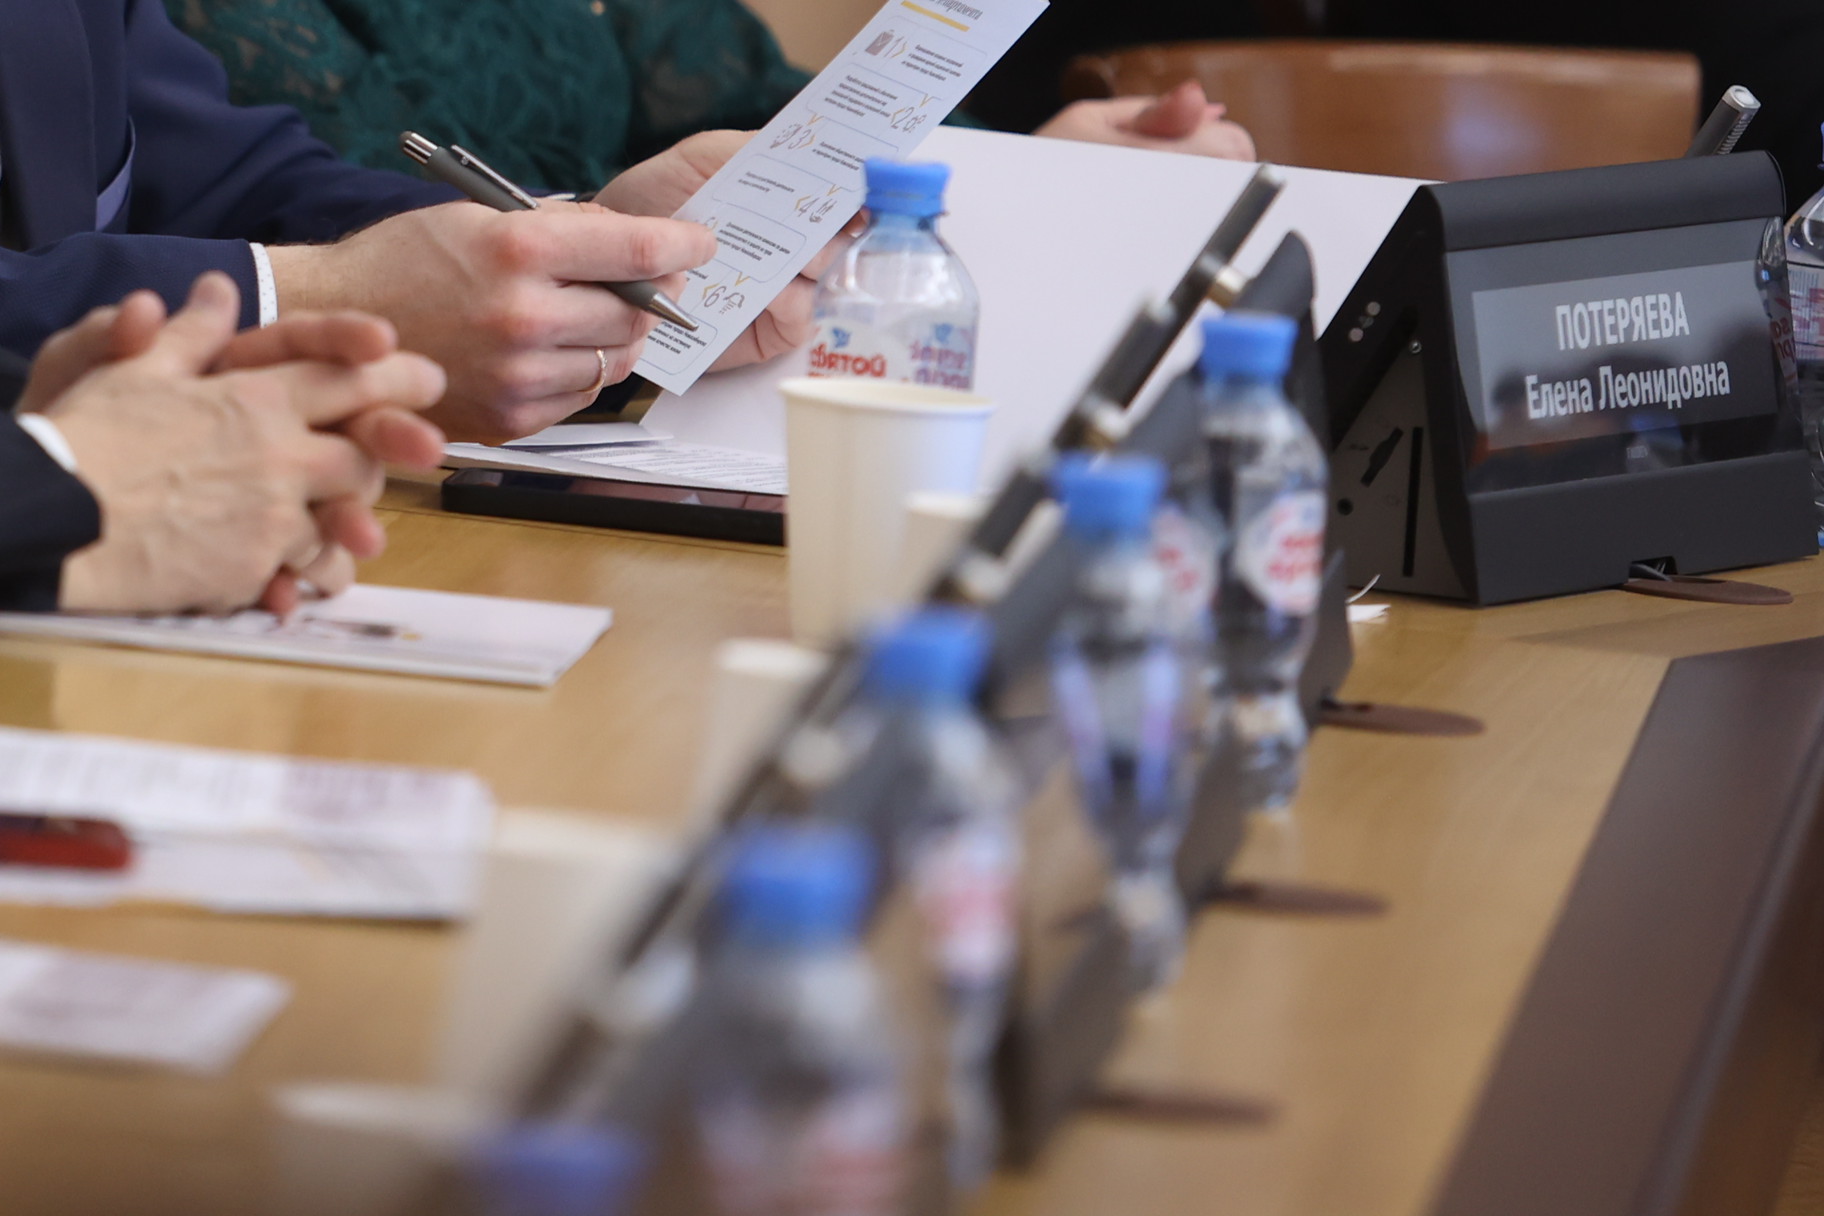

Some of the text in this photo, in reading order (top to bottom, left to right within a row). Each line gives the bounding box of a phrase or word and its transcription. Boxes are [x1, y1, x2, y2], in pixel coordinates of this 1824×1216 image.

[891, 106, 915, 129] 2
[788, 129, 812, 150] 3
[797, 196, 821, 217] 4
[704, 285, 727, 308] 6
[1555, 291, 1690, 351] ПОТЕРЯЕВА
[1525, 360, 1731, 420] Елена Леонидовна
